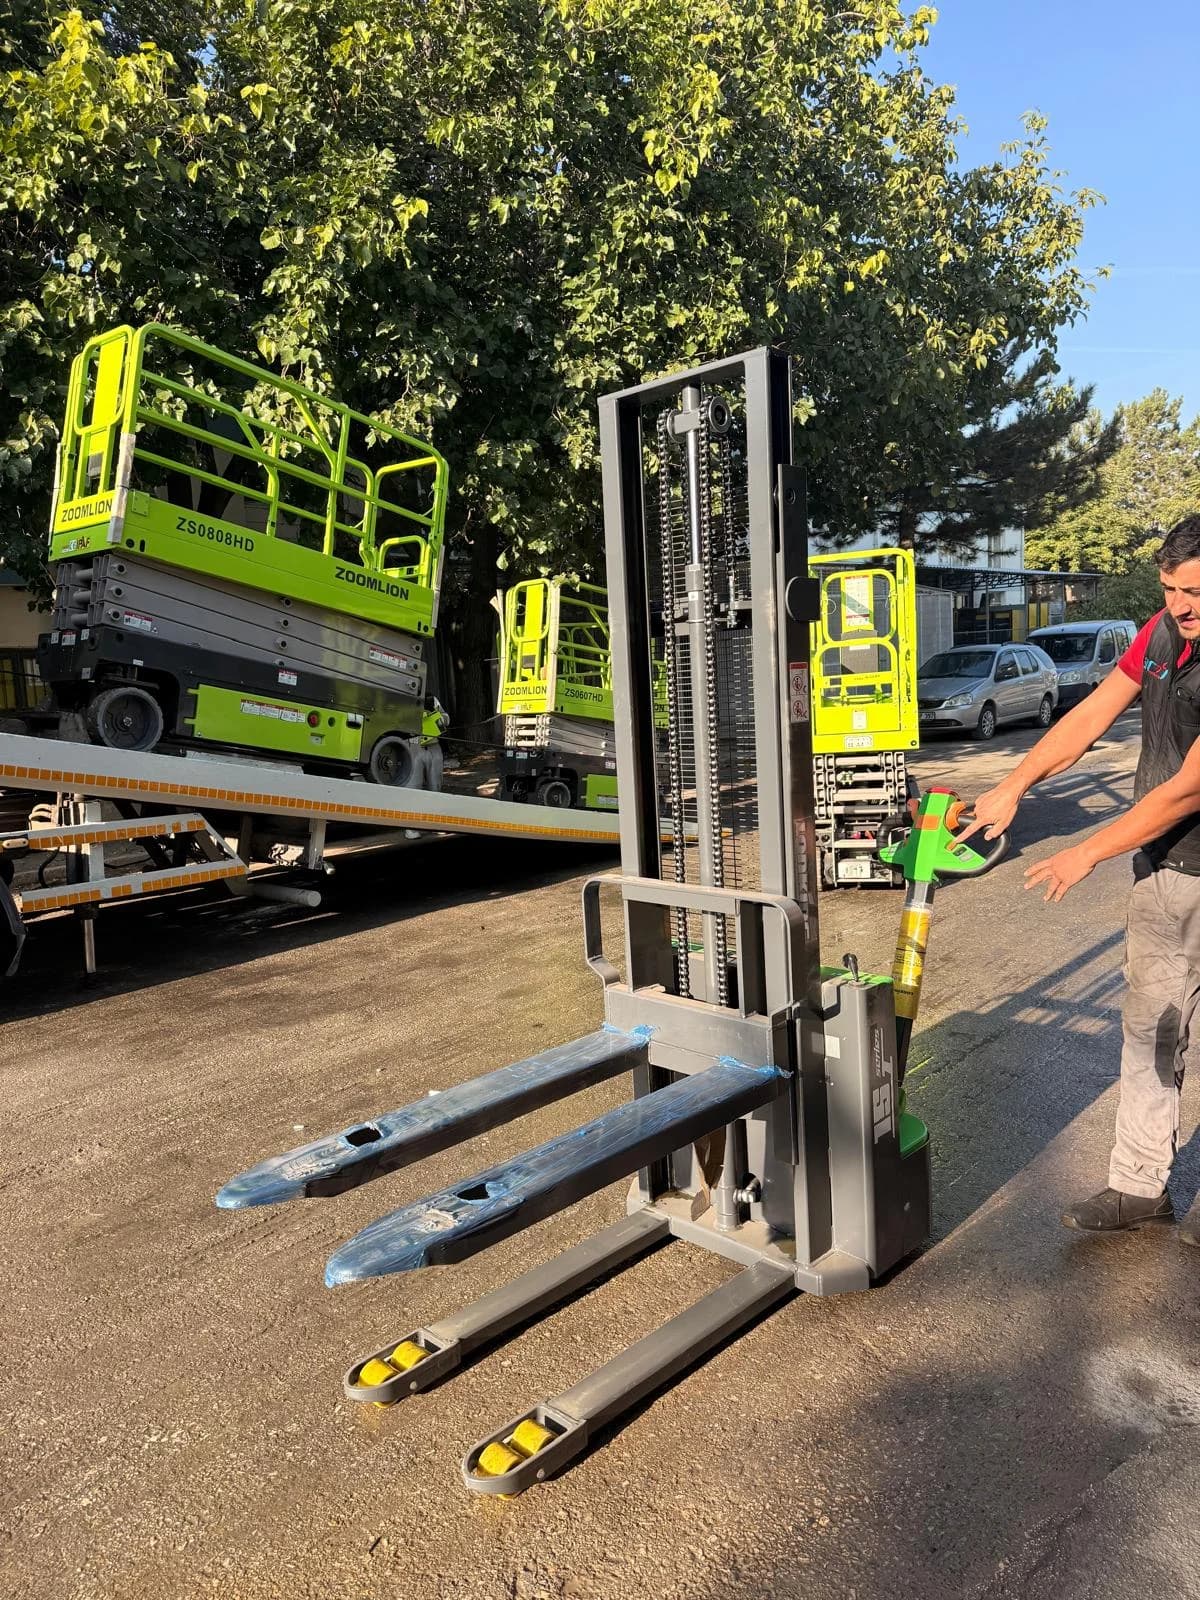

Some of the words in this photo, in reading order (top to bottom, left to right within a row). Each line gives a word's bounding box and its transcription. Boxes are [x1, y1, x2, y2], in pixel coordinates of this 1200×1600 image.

[61, 498, 113, 523] ZOOMLION
[176, 516, 255, 552] ZS0808HD
[335, 566, 410, 601] ZOOMLION
[504, 685, 547, 696] ZOOMLION
[564, 687, 604, 703] ZS0607HD
